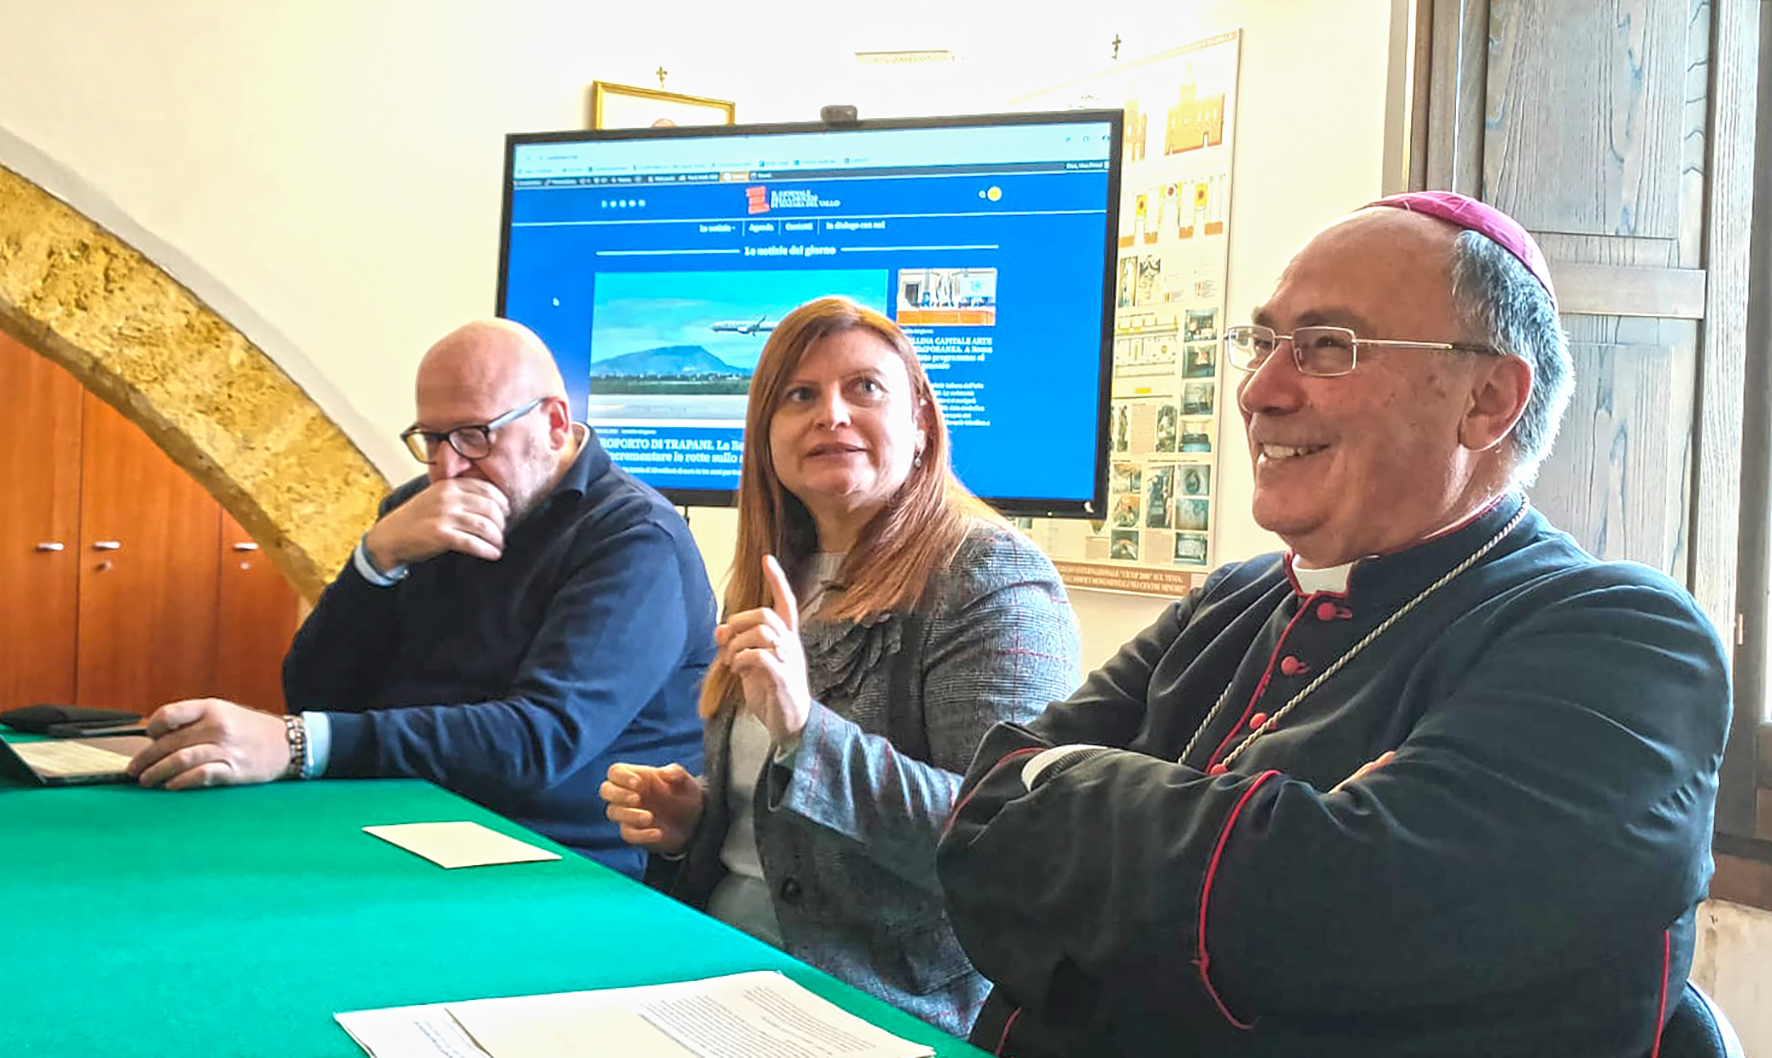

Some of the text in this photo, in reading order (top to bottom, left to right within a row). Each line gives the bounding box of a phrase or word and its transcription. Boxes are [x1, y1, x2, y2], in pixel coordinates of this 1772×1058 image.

[748, 222, 775, 234] Agenda
[785, 222, 813, 231] Contatti
[826, 221, 834, 230] In
[834, 220, 859, 231] dialogo
[744, 244, 837, 258] Le notizie del giorno
[935, 336, 971, 345] CAPITALE
[972, 337, 993, 345] ARTE
[964, 345, 970, 353] A
[599, 437, 650, 449] ROPORTO
[651, 438, 663, 449] DI
[664, 438, 715, 451] TRAPANI.
[716, 440, 730, 451] La
[608, 451, 673, 462] ncrementare
[673, 450, 684, 462] le
[685, 452, 710, 463] rotte
[711, 451, 738, 464] sullo
